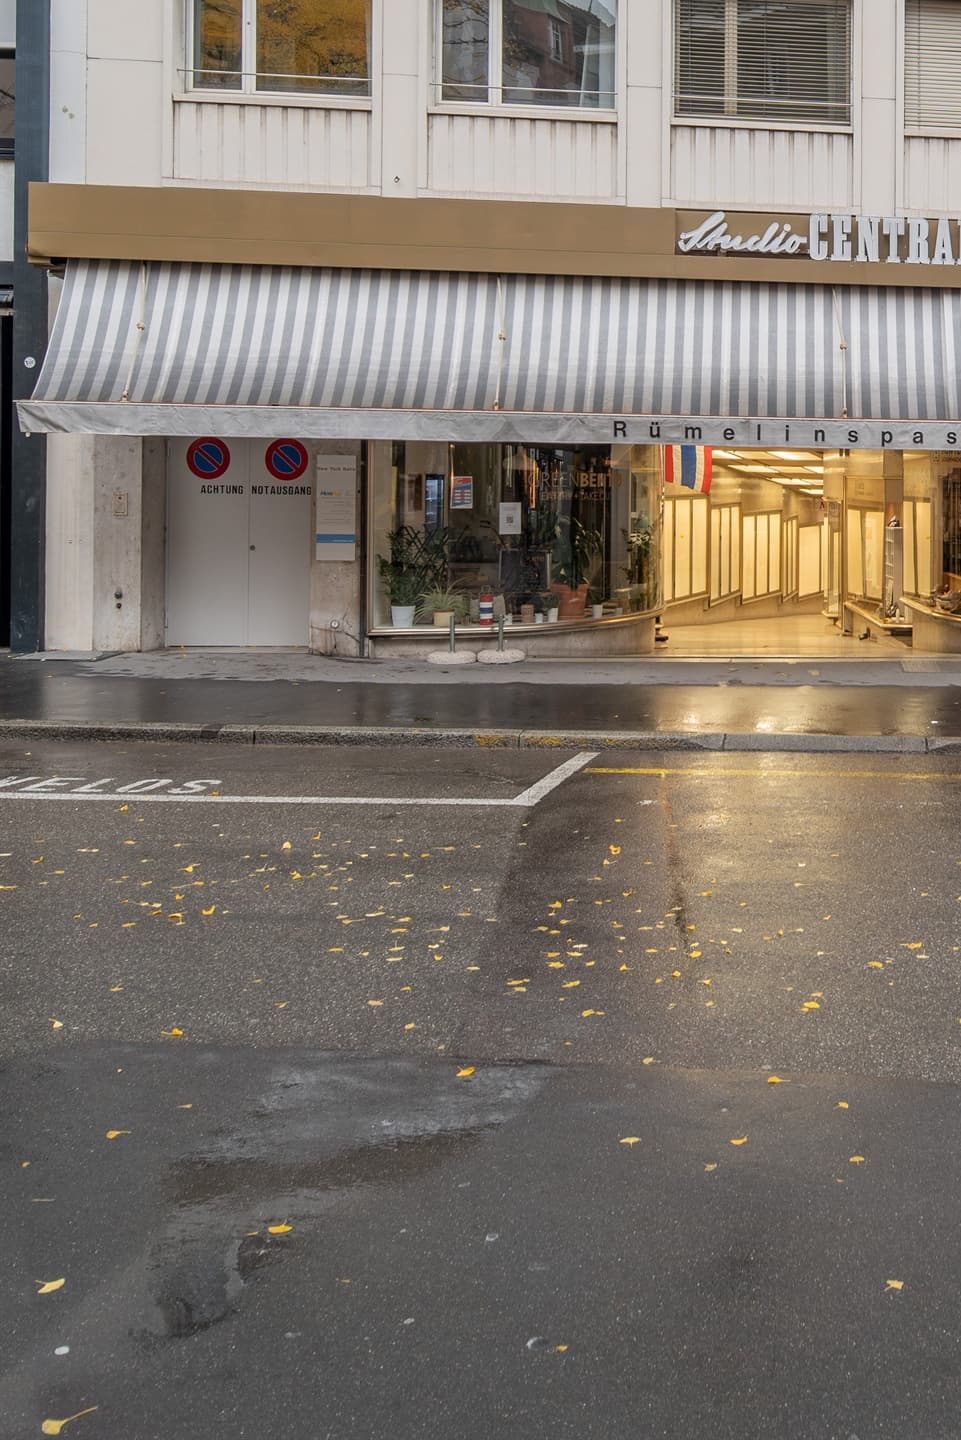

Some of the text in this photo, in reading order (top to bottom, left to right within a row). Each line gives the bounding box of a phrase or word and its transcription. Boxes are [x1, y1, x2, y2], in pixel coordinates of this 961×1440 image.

[679, 211, 807, 253] Studio
[200, 484, 244, 495] ACHTUNG
[251, 485, 312, 496] NOTAUSGANG
